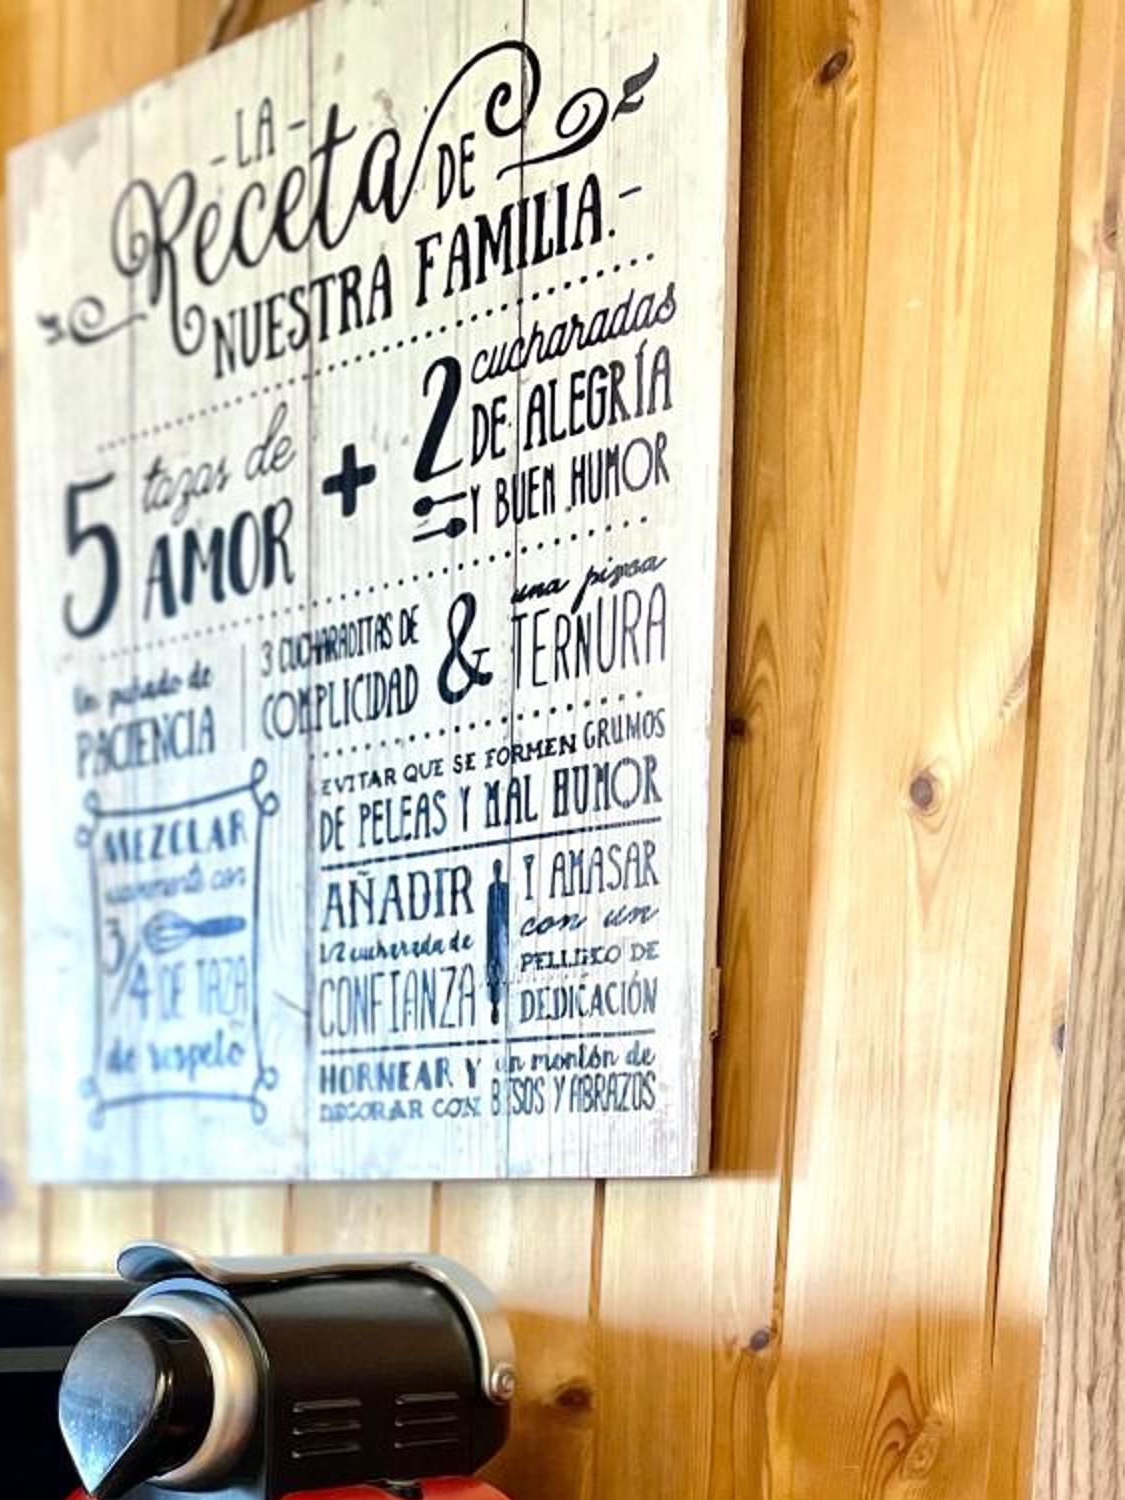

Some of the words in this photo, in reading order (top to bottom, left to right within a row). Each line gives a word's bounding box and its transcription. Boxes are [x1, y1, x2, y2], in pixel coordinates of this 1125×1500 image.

[234, 96, 275, 168] LA
[111, 40, 542, 357] Receta
[436, 131, 475, 210] DE
[213, 252, 393, 380] NUESTRA
[471, 281, 677, 385] cucharadas
[413, 355, 463, 483] 2
[470, 394, 507, 467] DE
[523, 338, 673, 452] ALEGRÍA
[143, 454, 230, 527] tazas
[246, 400, 296, 481] de
[471, 484, 480, 534] Y
[495, 463, 556, 529] BUEN
[571, 431, 671, 507] HUMOR
[63, 472, 121, 639] 5
[142, 496, 295, 622] AMOR
[510, 577, 570, 605] una
[261, 640, 274, 677] 3
[279, 611, 394, 674] CUCHARADITAS
[400, 604, 420, 647] DE
[437, 592, 493, 705] &
[511, 582, 667, 690] TERNURA
[262, 663, 419, 741] COMPLICIDAD
[77, 704, 216, 780] PACIENCIA
[322, 767, 397, 796] EVITAR
[403, 757, 444, 783] QUE
[452, 752, 476, 774] SE
[484, 733, 577, 770] FORMEN
[583, 707, 666, 750] GRUMOS
[104, 809, 249, 865] MEZCLAR
[320, 805, 345, 852] DE
[358, 789, 448, 849] PELEAS
[460, 785, 470, 832] Y
[484, 774, 538, 829] MAL
[553, 754, 663, 819] HUMOR
[320, 865, 474, 933] AÑADIR
[549, 839, 661, 899] AMASAR
[449, 929, 474, 953] de
[520, 913, 587, 938] con
[603, 904, 660, 929] un
[629, 940, 660, 962] DE
[319, 962, 476, 1038] CONFIANZA
[519, 970, 658, 1024] DEDICACIÓN
[320, 1056, 454, 1095] HORNEAR
[465, 1057, 481, 1089] Y
[625, 1039, 656, 1067] de
[553, 1074, 566, 1114] Y
[569, 1070, 656, 1114] ABRAZOS
